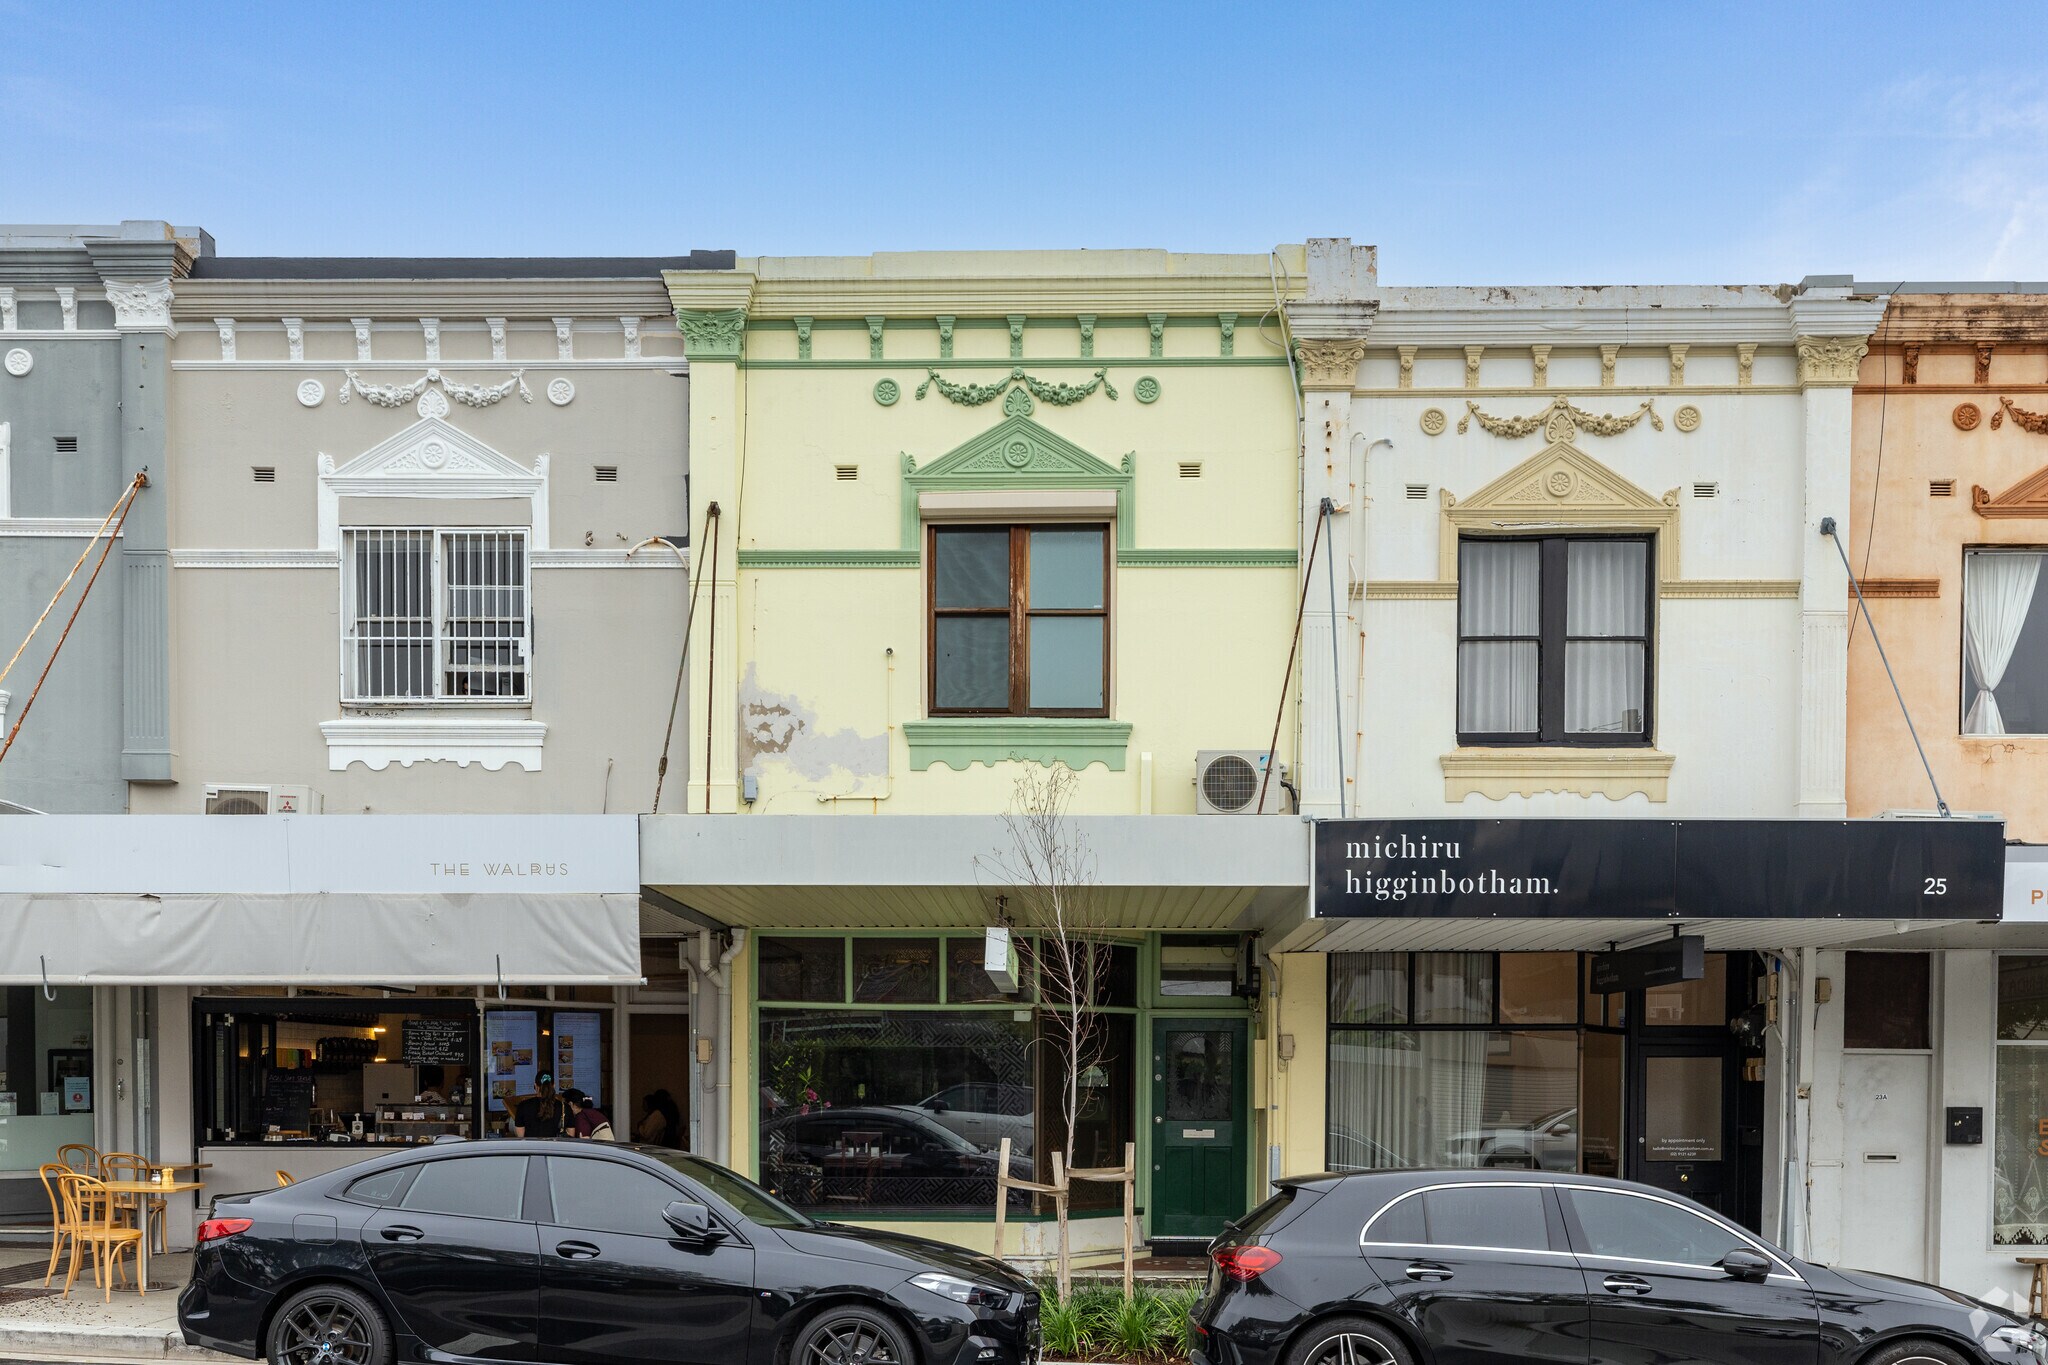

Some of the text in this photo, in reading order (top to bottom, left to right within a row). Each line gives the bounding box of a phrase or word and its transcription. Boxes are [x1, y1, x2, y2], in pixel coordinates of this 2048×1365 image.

[1345, 833, 1461, 859] michiru
[430, 862, 569, 876] THE WALRUS
[1345, 869, 1559, 901] higginbotham.
[1923, 877, 1947, 895] 25
[2031, 889, 2048, 905] P
